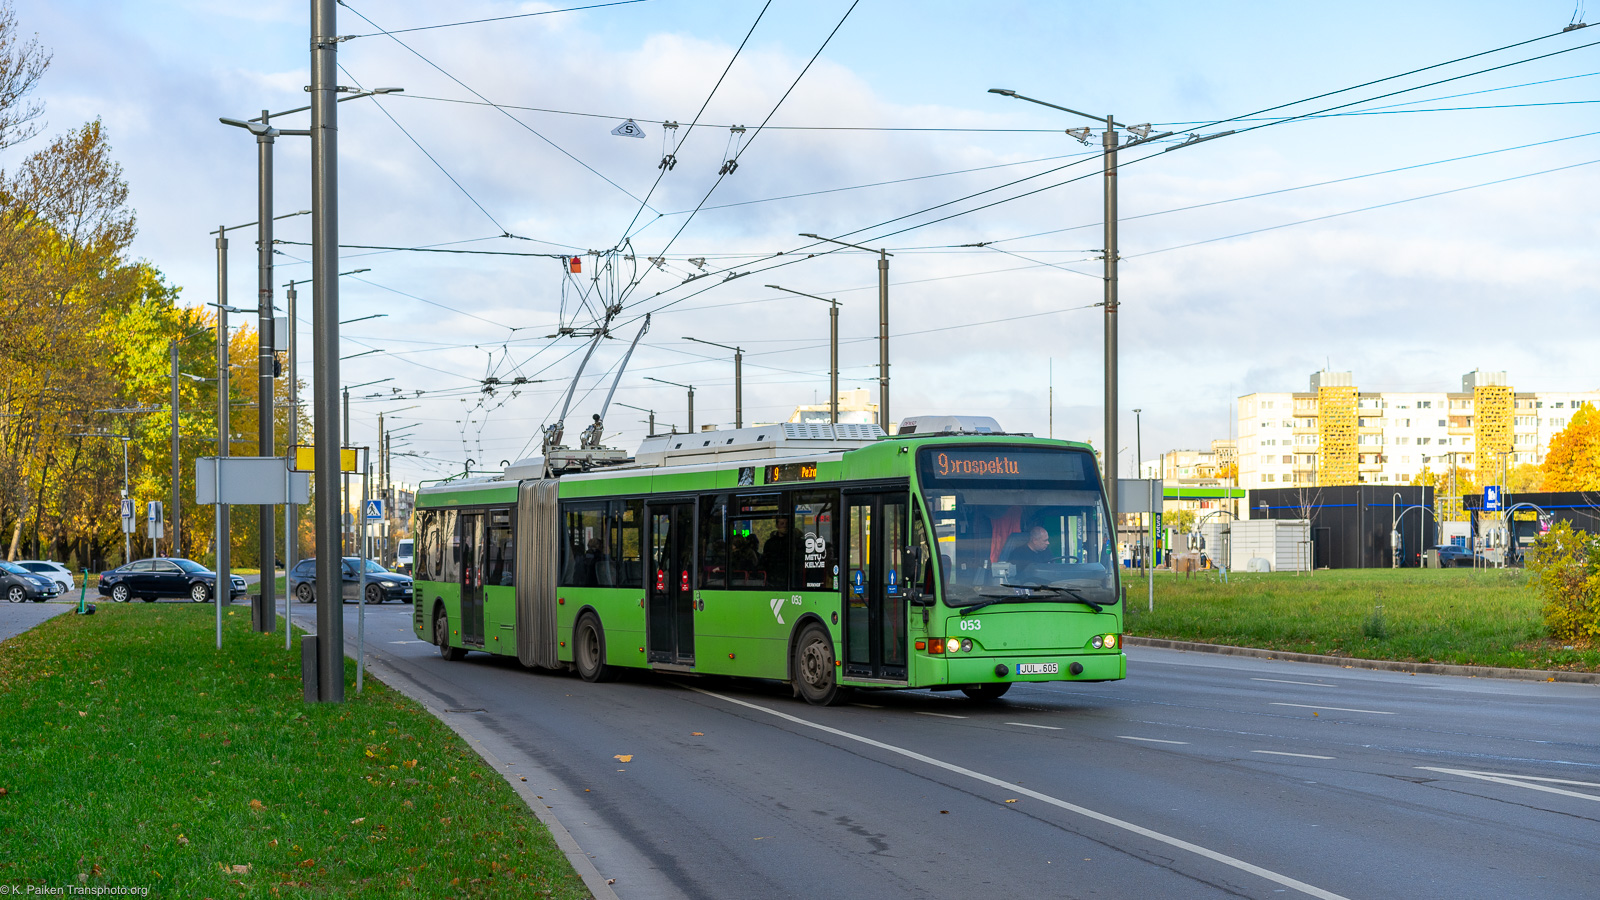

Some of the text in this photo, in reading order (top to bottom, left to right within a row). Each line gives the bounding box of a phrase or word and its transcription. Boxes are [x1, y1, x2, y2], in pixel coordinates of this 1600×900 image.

[625, 126, 634, 134] S
[938, 453, 948, 475] 9
[774, 467, 779, 481] 9
[805, 538, 826, 553] 90
[792, 595, 802, 606] 053
[960, 620, 981, 630] 053
[1021, 664, 1057, 673] JUL 605
